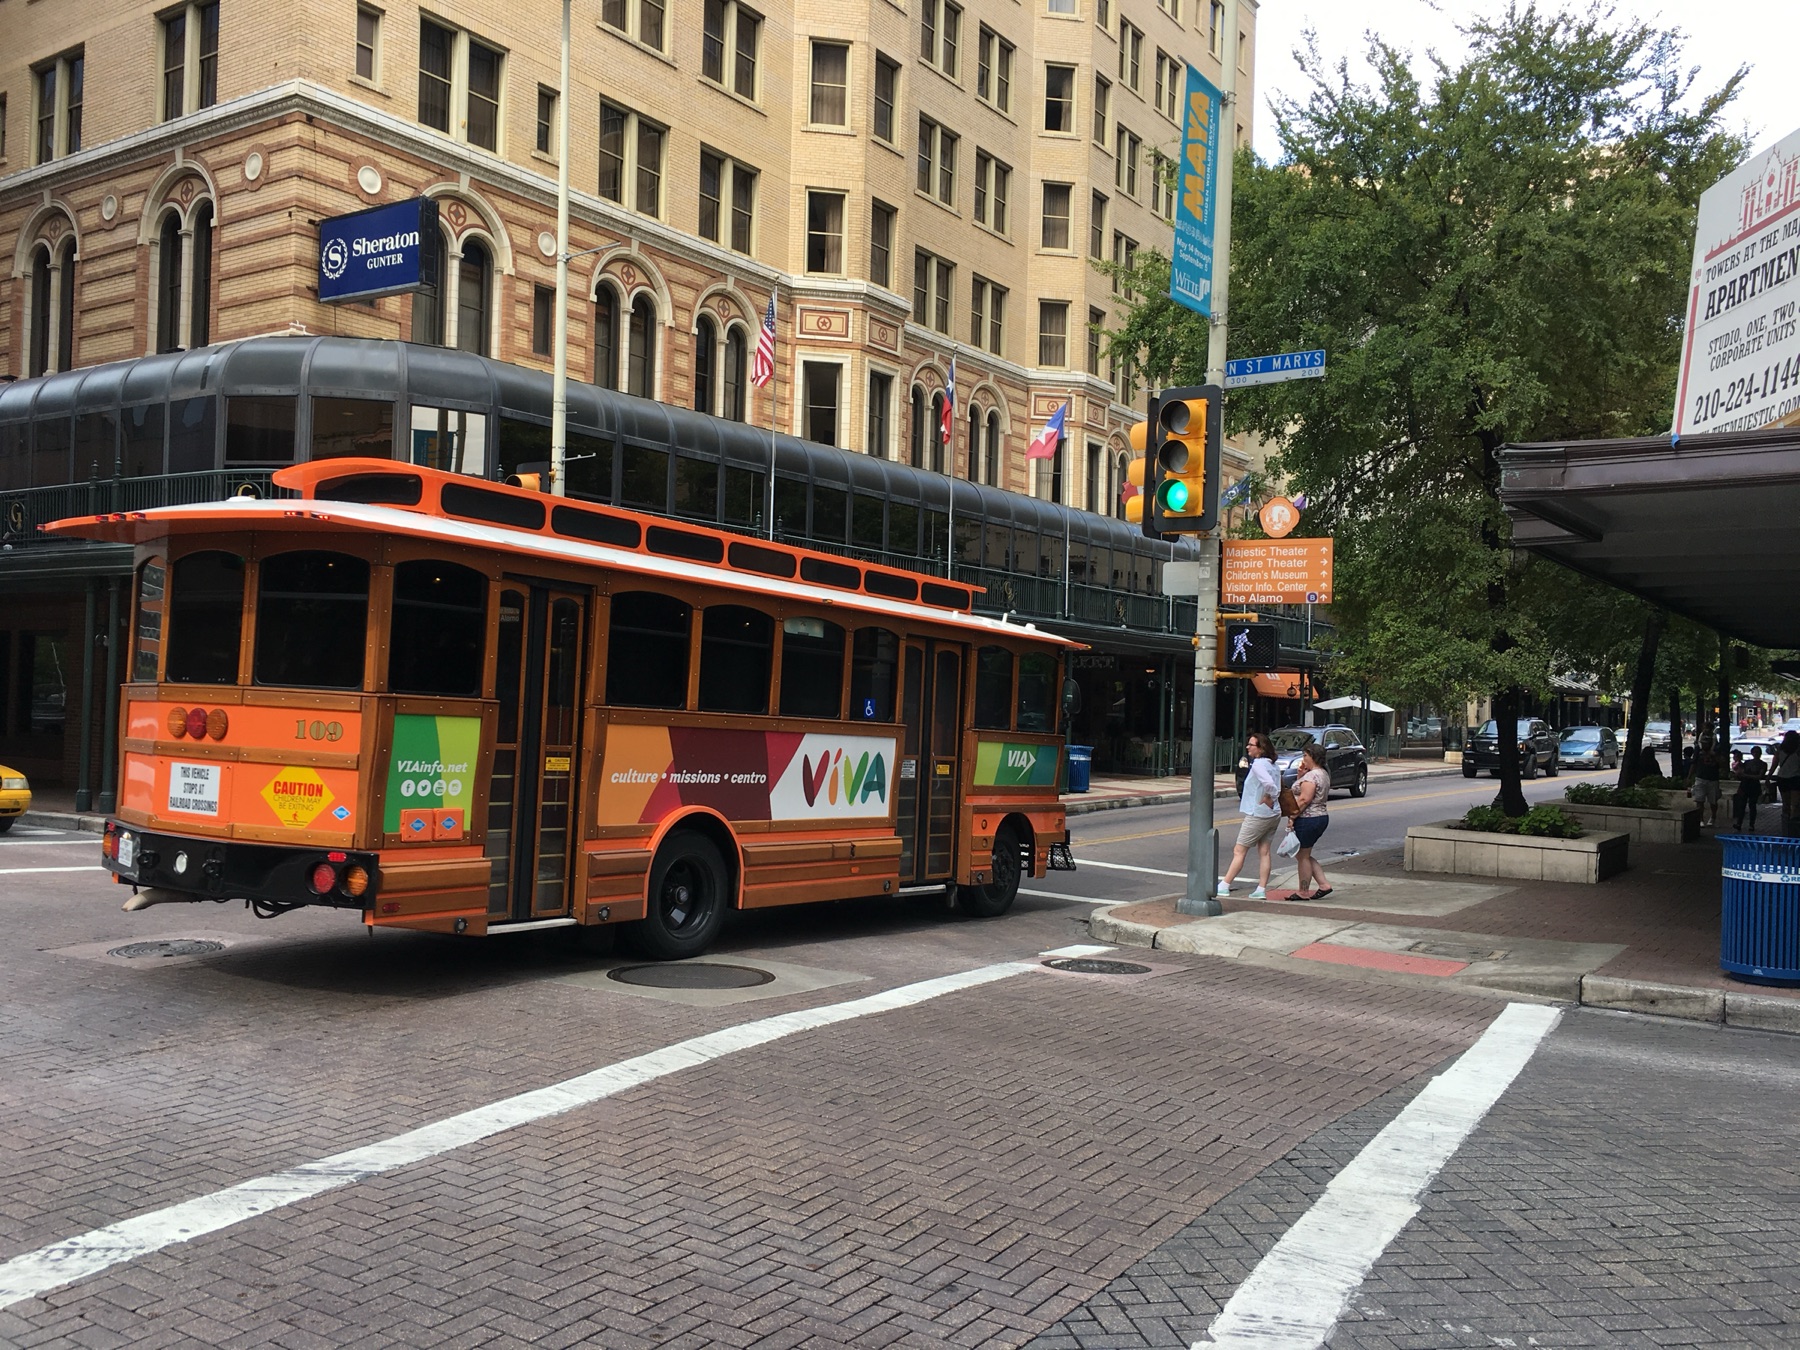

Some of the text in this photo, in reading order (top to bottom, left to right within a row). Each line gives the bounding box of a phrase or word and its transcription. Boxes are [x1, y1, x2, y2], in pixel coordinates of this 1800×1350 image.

[1184, 91, 1210, 222] MAYA
[352, 231, 420, 257] Sheraton
[1176, 236, 1212, 263] May 14 through
[367, 253, 404, 269] GUNTER
[1179, 249, 1204, 269] September
[1706, 251, 1741, 283] TOWERS
[1743, 242, 1757, 263] AT
[1760, 229, 1779, 253] THE
[1708, 301, 1795, 356] STUDIO, ONE, TWO
[1710, 319, 1797, 372] CORPORATE UNITS
[1229, 352, 1321, 375] N ST MARYS
[1231, 376, 1247, 385] 300
[1301, 368, 1320, 377] 200
[1693, 353, 1800, 426] 210-224-1144
[1226, 546, 1308, 558] Majestic Theater
[1226, 558, 1308, 569] Empire Theater
[1225, 570, 1308, 580] Children's Museum
[1226, 582, 1308, 592] Visitor Info. Center
[1226, 593, 1246, 603] The
[1248, 593, 1283, 603] Alamo
[295, 719, 344, 742] 109
[181, 766, 210, 780] THIS VEHICLE
[397, 760, 468, 776] VIAinfo.net
[611, 768, 767, 783] culture missions centro
[183, 782, 205, 795] STOPS AT
[273, 781, 324, 797] CAUTION
[169, 796, 218, 812] RAILROAD CROSSINGS
[273, 794, 305, 803] CHILDREN
[288, 803, 315, 811] EXITING
[1724, 869, 1752, 878] RECYCLE
